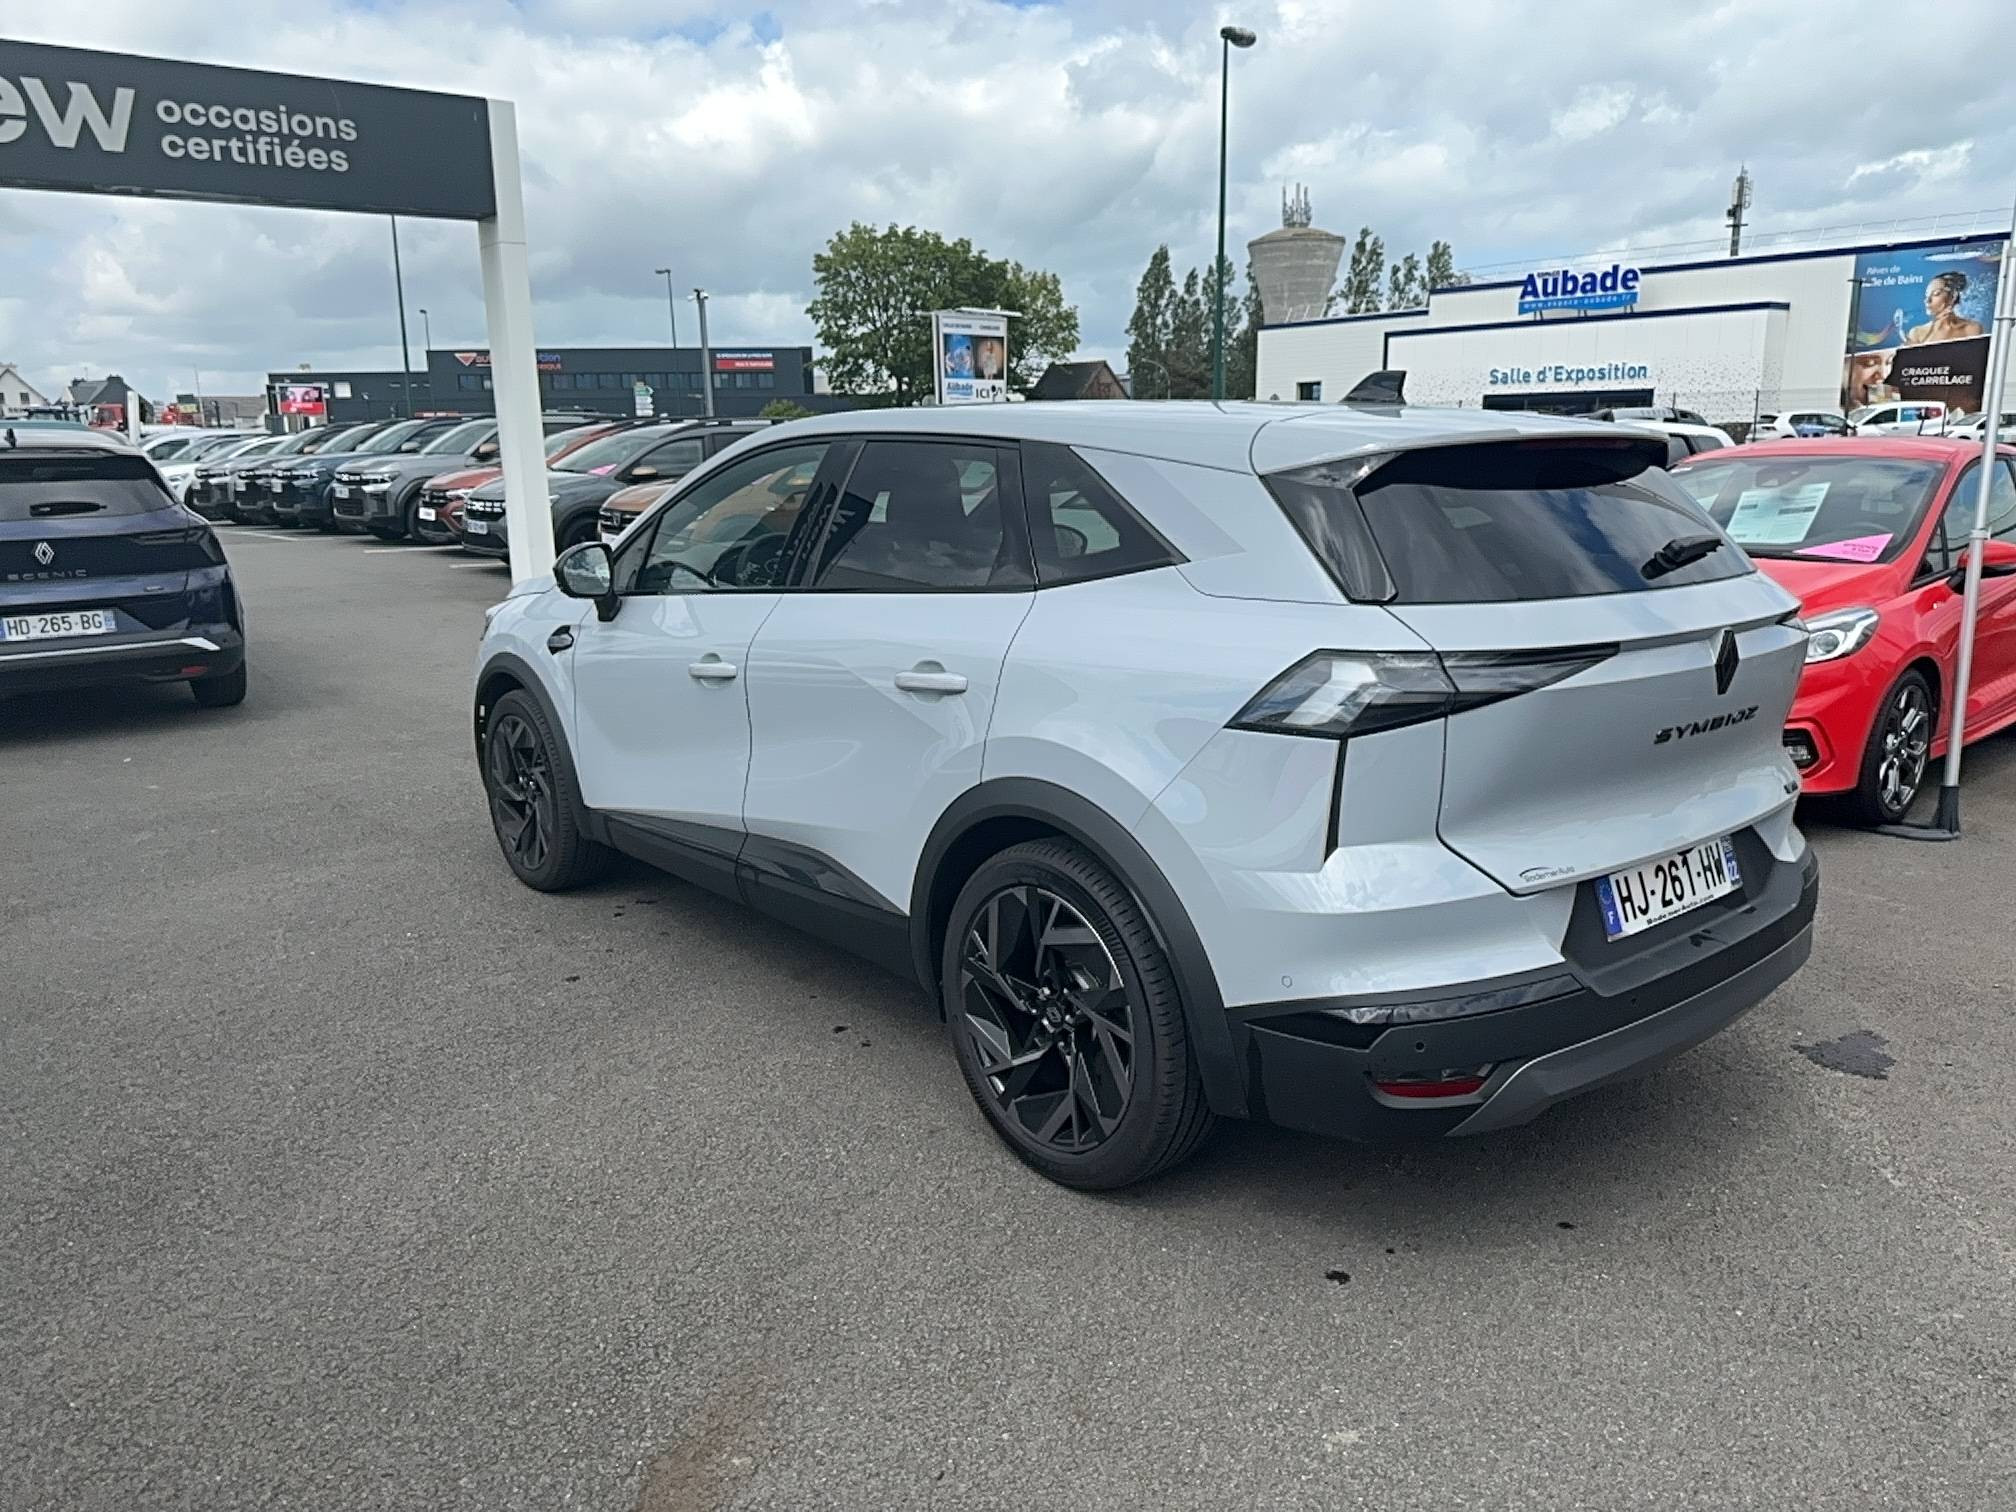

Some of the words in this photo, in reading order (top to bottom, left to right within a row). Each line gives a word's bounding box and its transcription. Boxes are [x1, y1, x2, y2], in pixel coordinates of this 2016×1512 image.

[156, 100, 358, 142] occasions
[161, 135, 350, 172] certifiées
[1520, 264, 1639, 299] Aubade
[1884, 275, 1896, 286] de
[1897, 274, 1924, 285] Bains
[1489, 367, 1531, 385] Salle
[1537, 362, 1648, 384] d'Exposition
[1901, 366, 1950, 376] CRAQUEZ
[1911, 375, 1973, 386] CARRELAGE
[1654, 704, 1760, 744] SYMBIOZ
[1606, 910, 1614, 925] F
